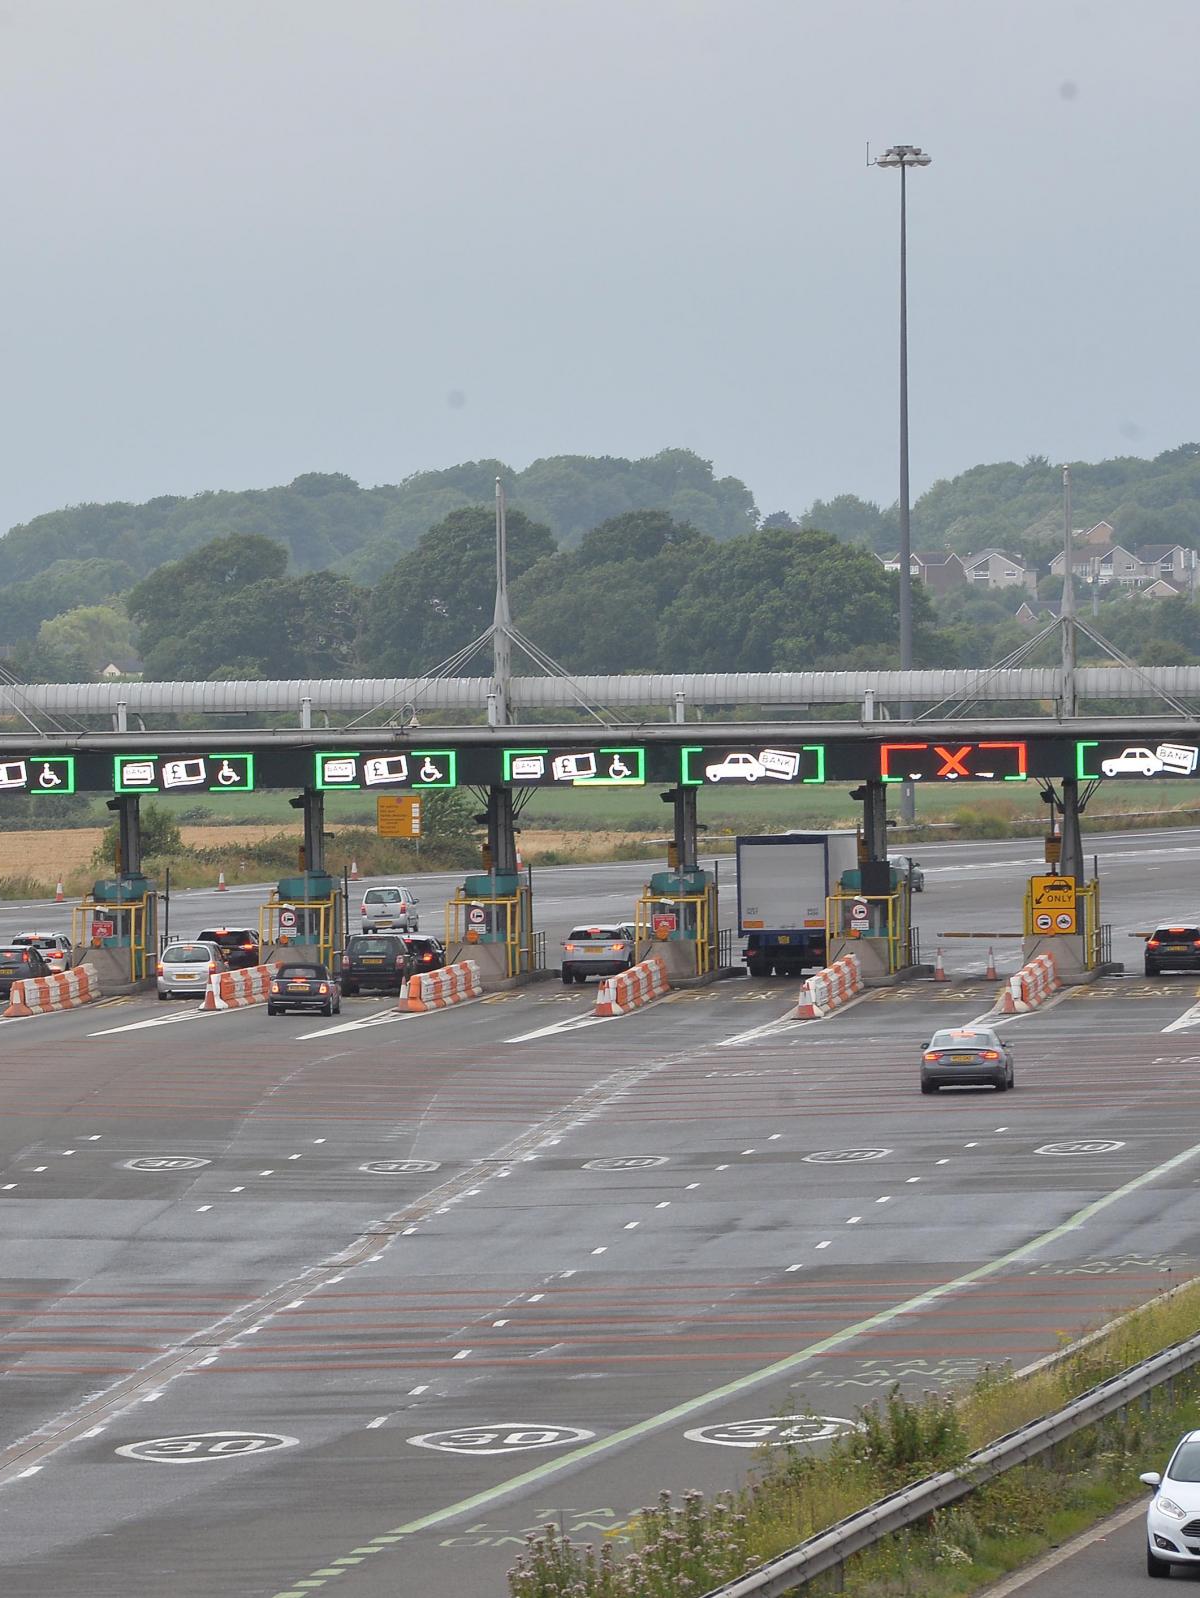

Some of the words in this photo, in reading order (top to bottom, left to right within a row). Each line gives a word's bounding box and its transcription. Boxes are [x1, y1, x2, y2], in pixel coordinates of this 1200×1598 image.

[1159, 748, 1189, 760] BANK
[762, 754, 790, 766] BANK
[1050, 1144, 1110, 1152] 30
[373, 1163, 426, 1171] 30
[855, 1358, 981, 1368] TAG
[806, 1367, 979, 1378] LANE
[790, 1377, 978, 1388] ONLY
[714, 1424, 840, 1438] 30
[439, 1431, 559, 1445] 30
[144, 1440, 265, 1454] 30
